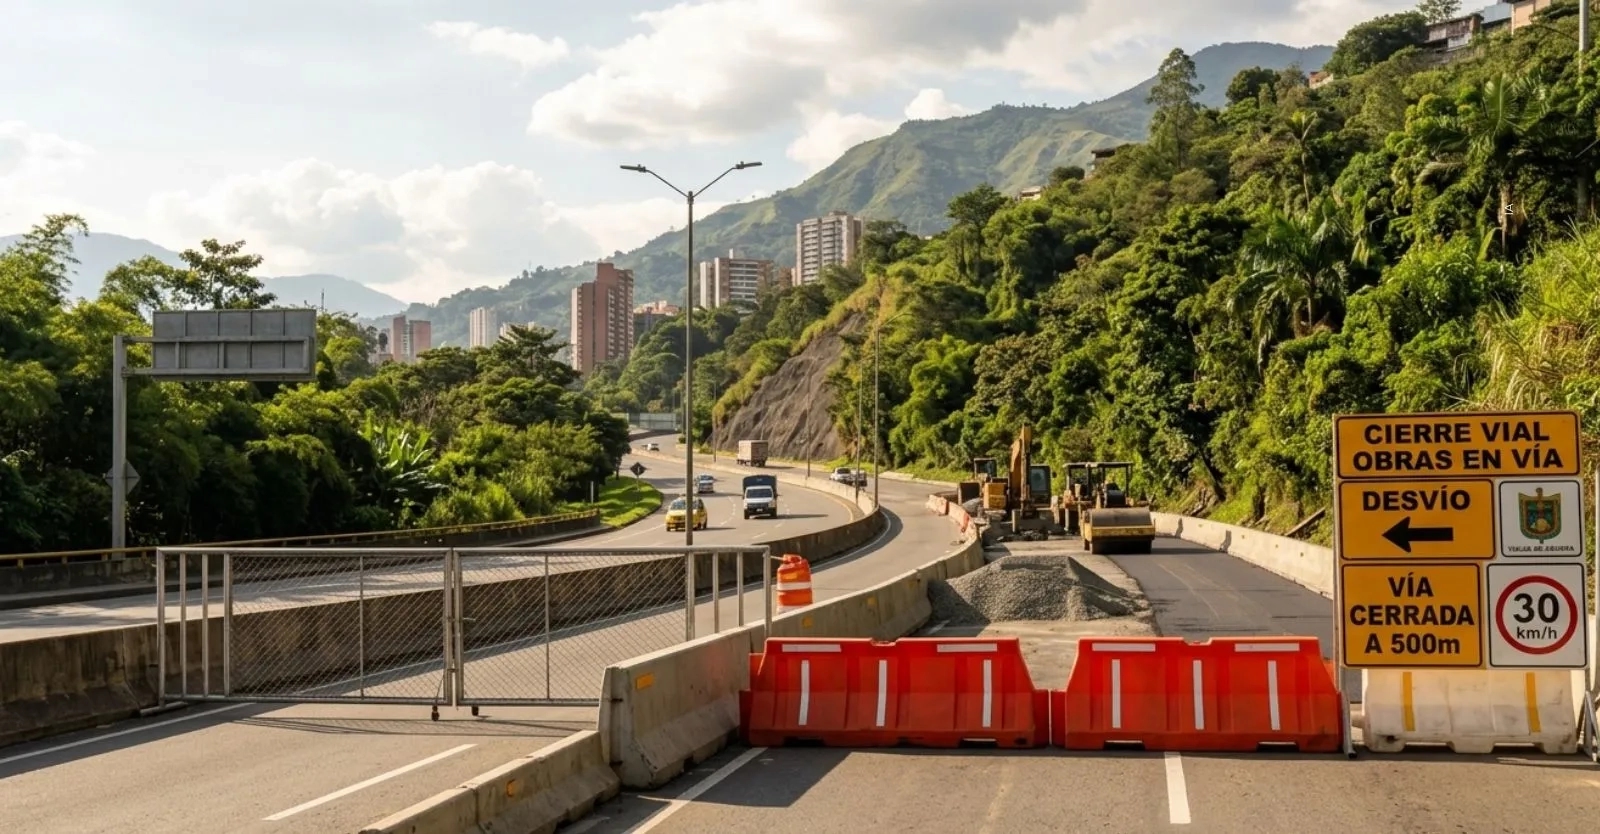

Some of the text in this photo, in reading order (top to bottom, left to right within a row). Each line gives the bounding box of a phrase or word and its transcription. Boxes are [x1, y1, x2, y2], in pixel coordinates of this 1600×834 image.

[1365, 422, 1549, 444] CIERRE VIAL
[1353, 443, 1563, 471] OBRAS EN VÍA
[1363, 485, 1470, 511] DESVÍO
[1388, 572, 1433, 597] VÍA
[1350, 605, 1474, 625] CERRADA
[1513, 592, 1560, 623] 30
[1365, 633, 1459, 654] A 500m
[1516, 626, 1557, 639] km/h
